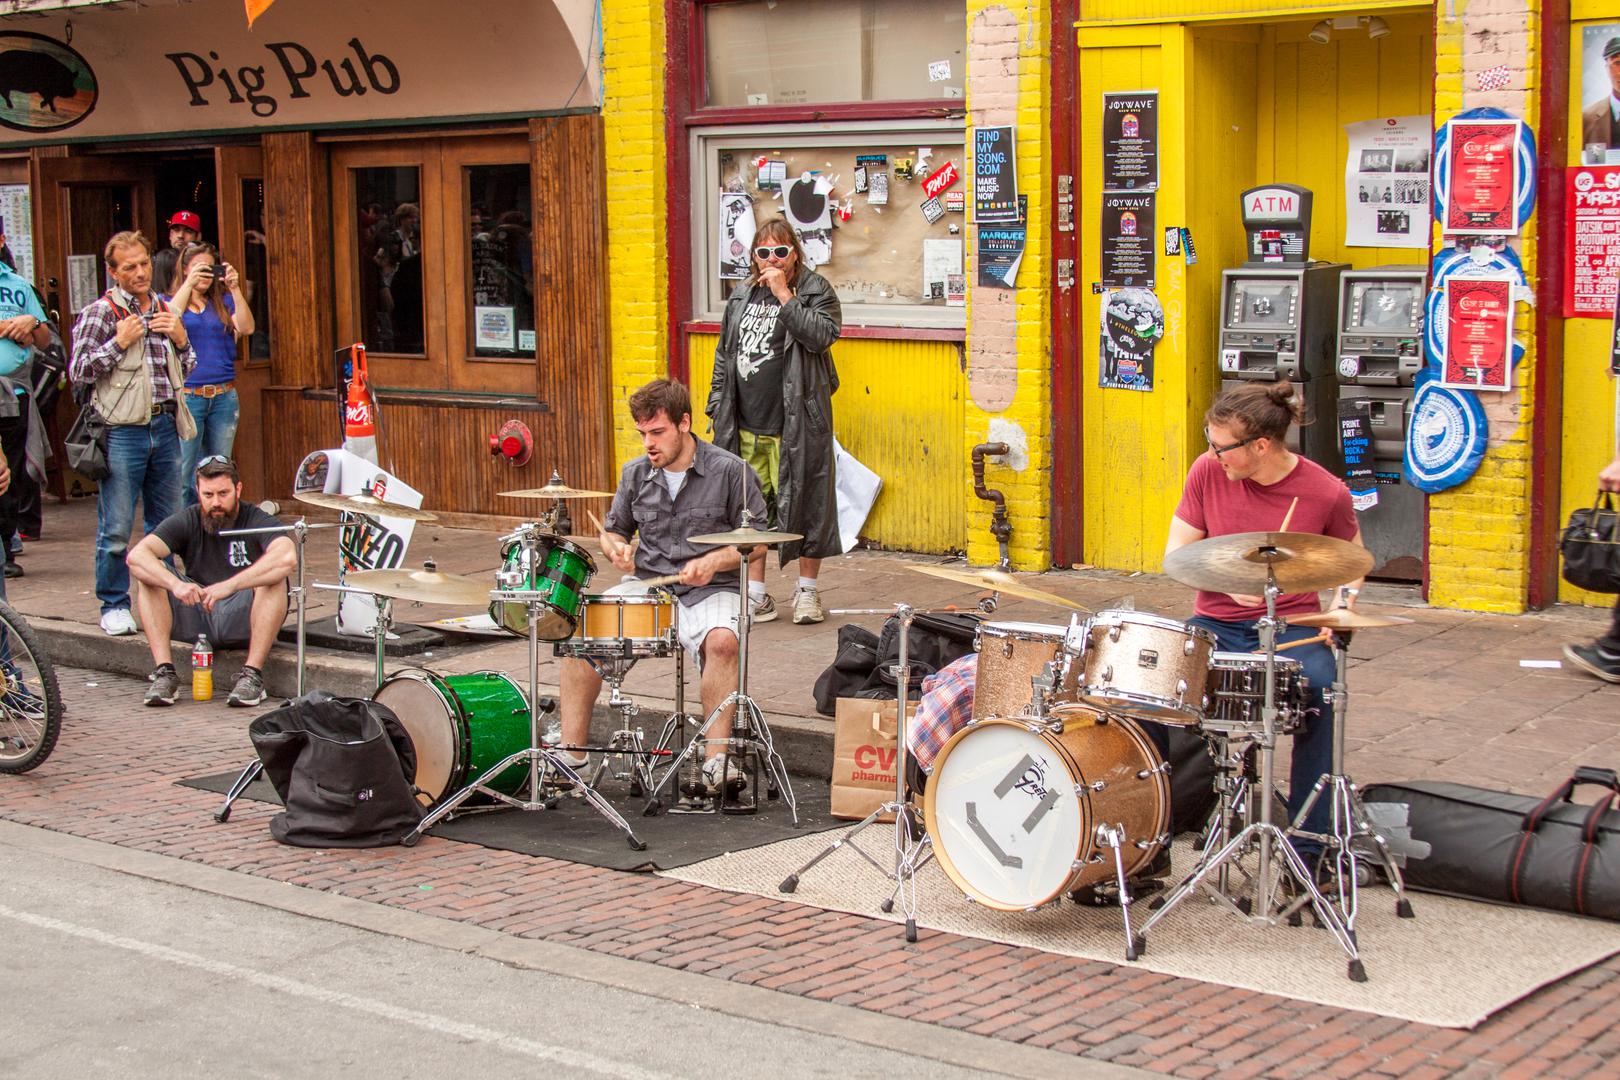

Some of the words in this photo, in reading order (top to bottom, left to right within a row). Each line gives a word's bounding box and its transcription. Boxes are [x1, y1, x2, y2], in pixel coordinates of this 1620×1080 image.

[165, 50, 278, 118] Pig
[264, 37, 401, 99] Pub
[1108, 100, 1152, 110] JOYWAVE
[976, 131, 1000, 142] FIND
[976, 143, 993, 153] MY
[977, 153, 1007, 164] SONG.
[977, 164, 1000, 175] COM
[976, 177, 997, 185] MAKE
[976, 185, 1000, 193] MUSIC
[976, 192, 995, 201] NOW
[1107, 198, 1150, 207] JOYWAVE
[1252, 197, 1292, 213] ATM
[1576, 221, 1602, 233] DATSIK
[980, 231, 1025, 241] MARQUEE
[1575, 245, 1605, 255] SPECIAL
[1575, 255, 1591, 267] SPL
[1574, 284, 1594, 294] PLUS
[1342, 420, 1361, 428] PRINT
[1343, 429, 1355, 438] ART
[1345, 455, 1361, 464] ROLL
[854, 744, 897, 771] CV
[851, 770, 897, 784] pharma
